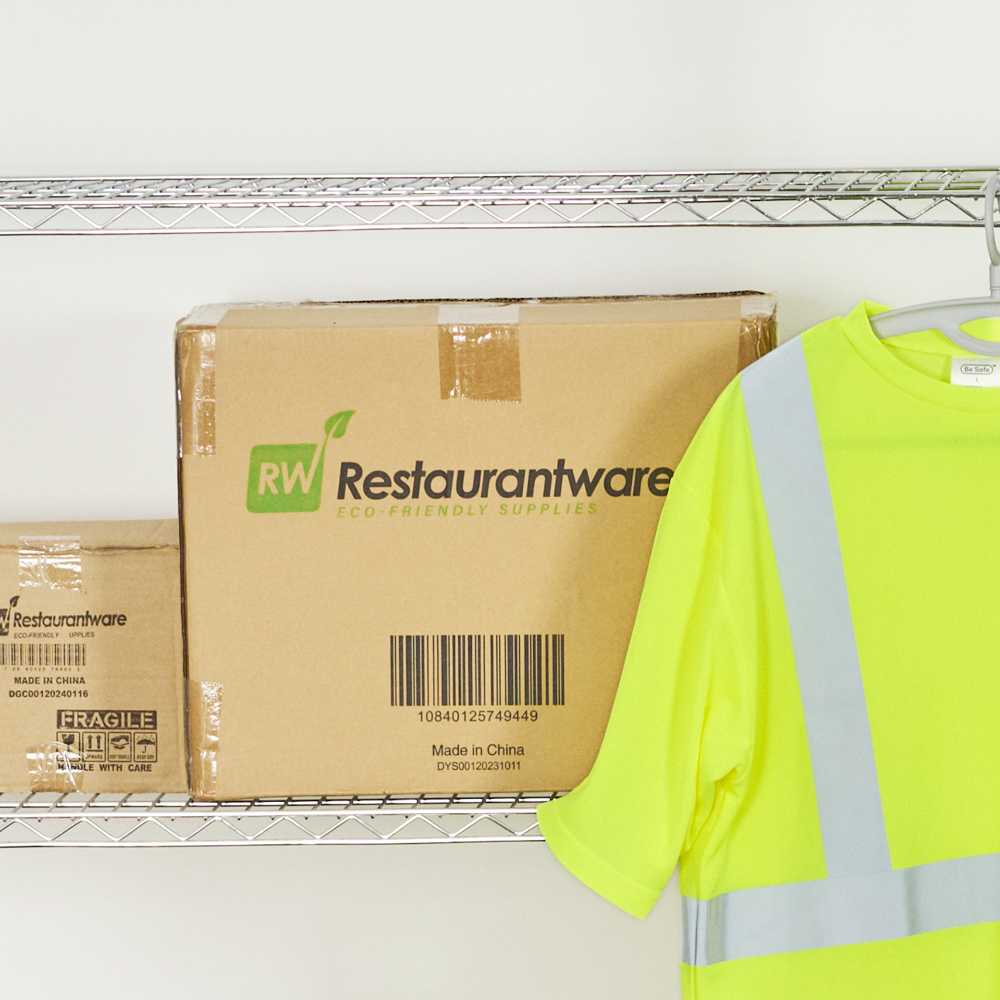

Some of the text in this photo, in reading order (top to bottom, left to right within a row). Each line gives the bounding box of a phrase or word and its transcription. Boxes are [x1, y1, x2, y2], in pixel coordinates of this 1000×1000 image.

[258, 461, 316, 496] RW
[337, 458, 675, 500] Restaurantware
[336, 501, 600, 518] ECO-FRIENDLY SUPPLIES
[13, 610, 128, 628] Restaurantware
[14, 676, 86, 685] MADE IN CHINA
[8, 689, 89, 698] DGC00120240116
[60, 711, 154, 729] FRAGILE
[417, 710, 539, 723] 10840125749449
[432, 744, 525, 756] Made in China
[99, 763, 123, 772] WITH
[127, 763, 153, 772] CARE
[437, 761, 521, 771] DYS00120231011
